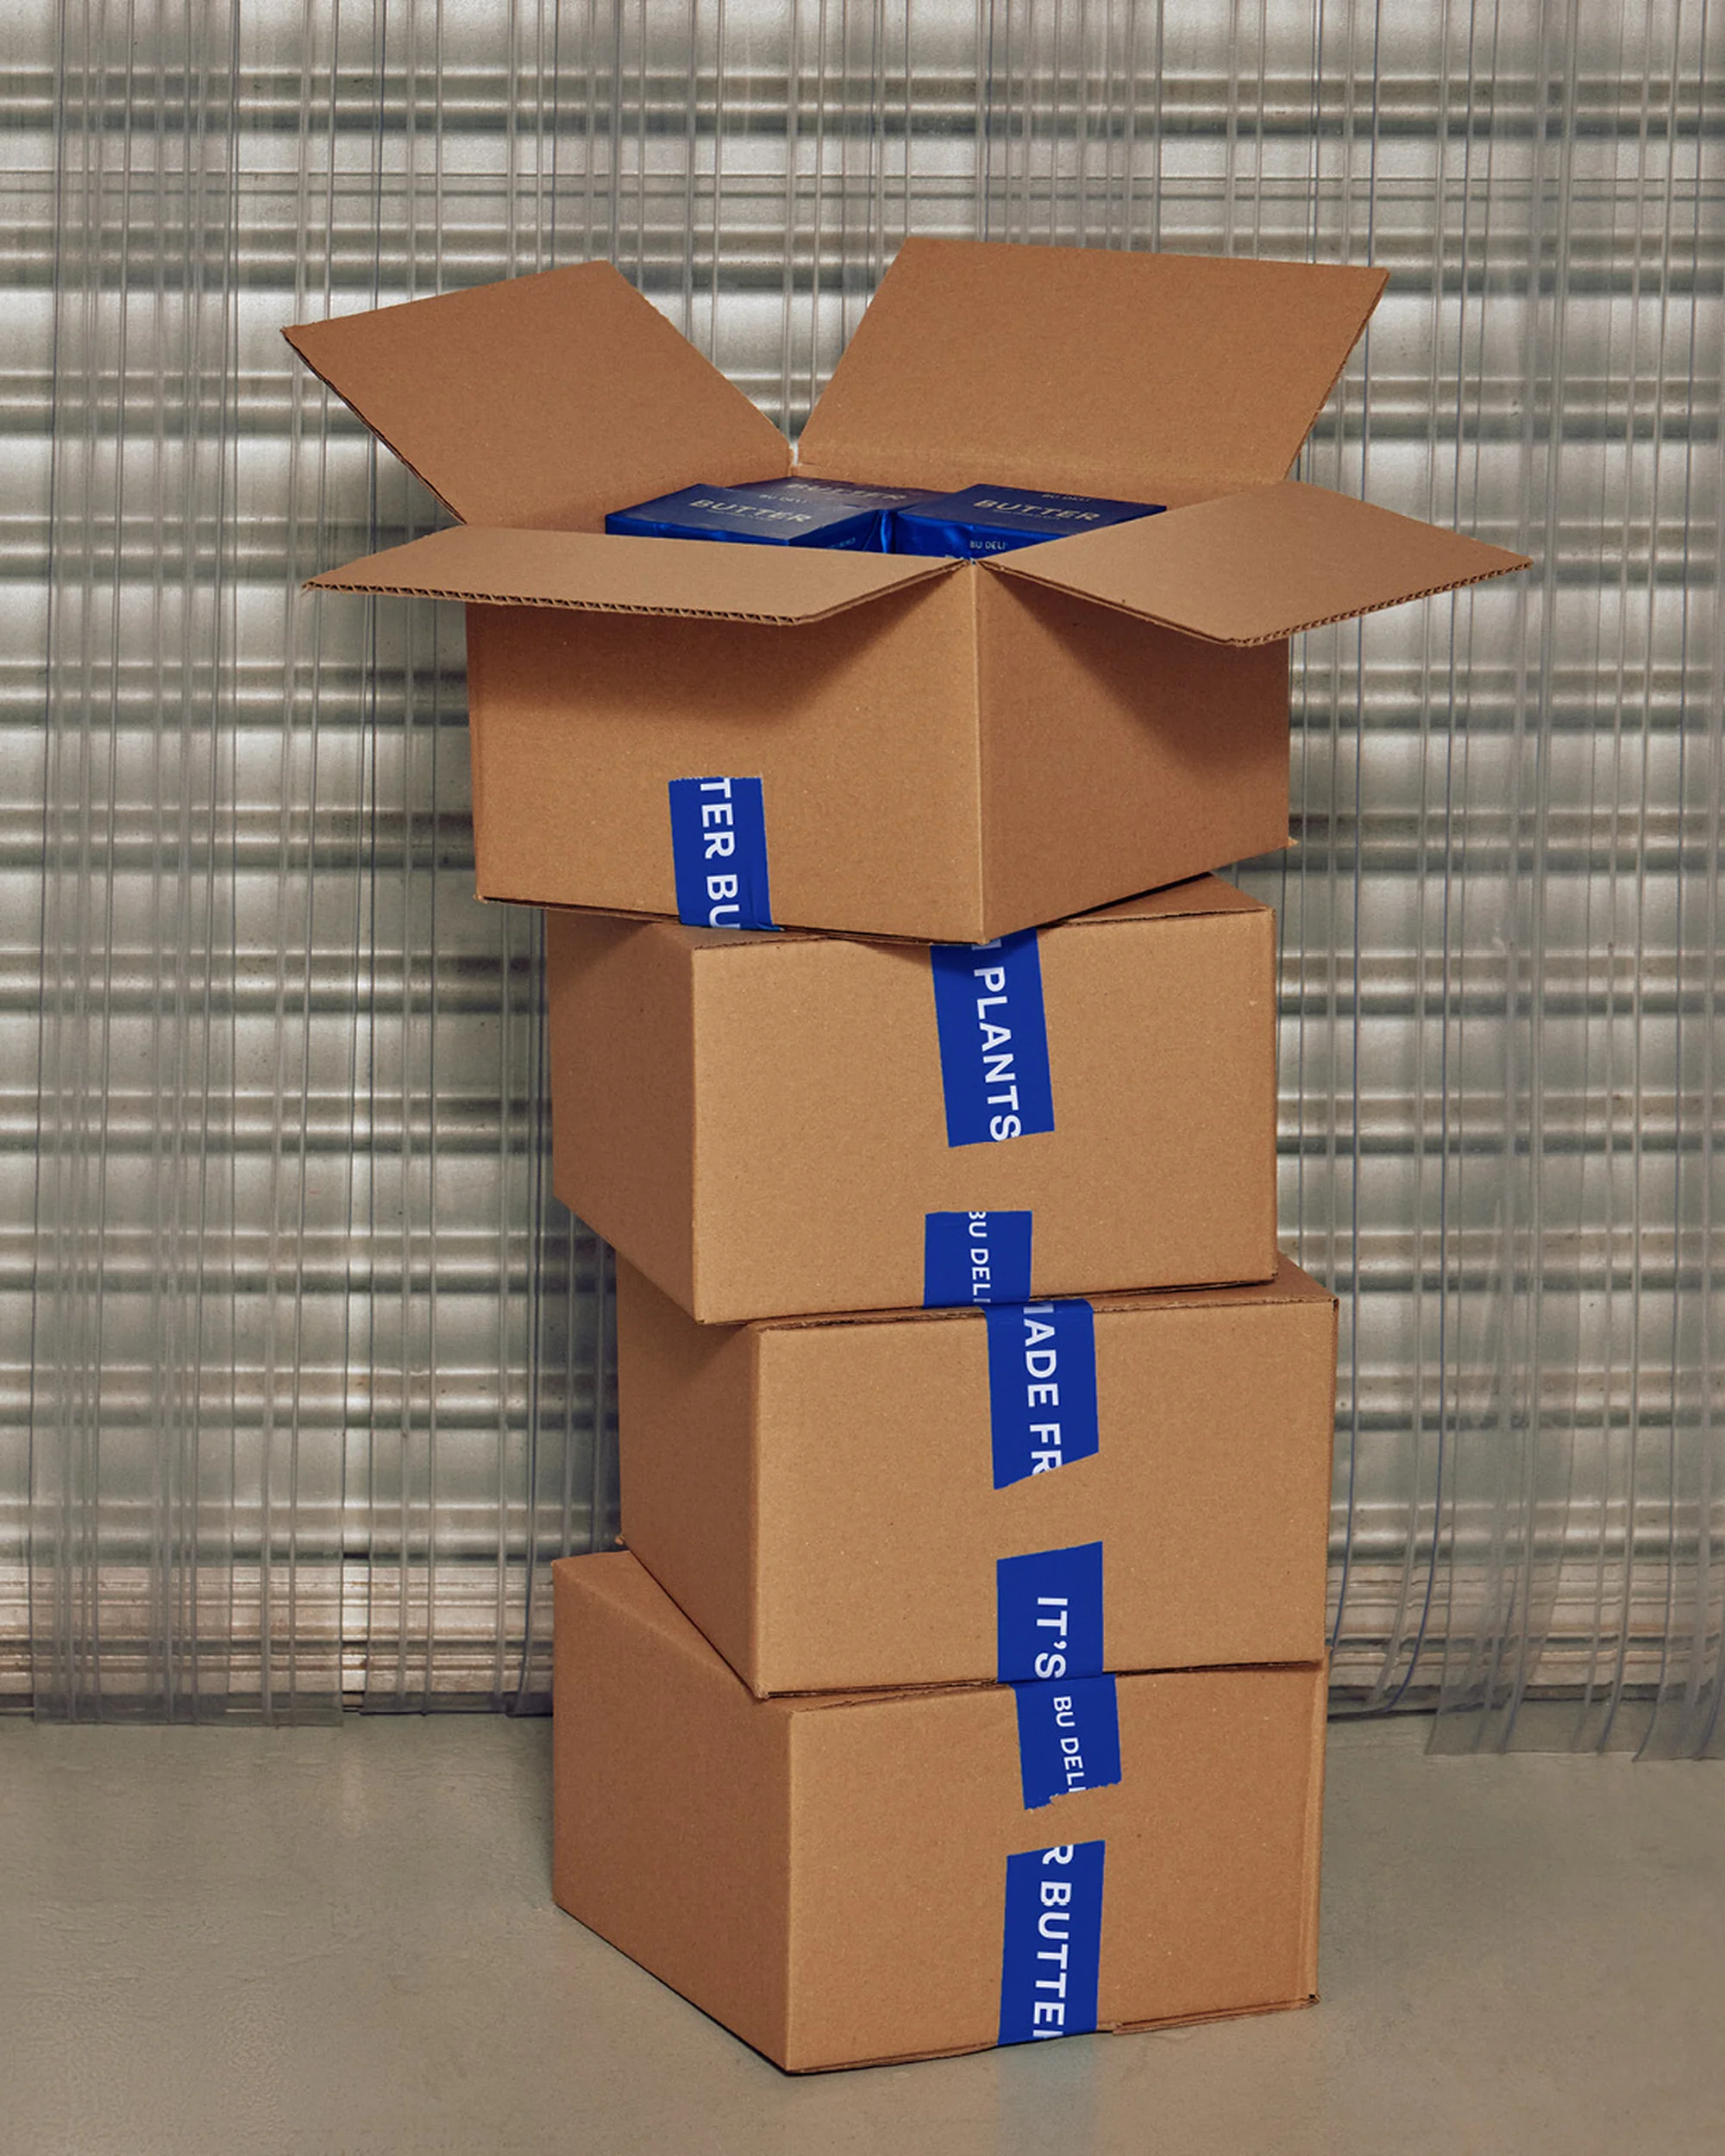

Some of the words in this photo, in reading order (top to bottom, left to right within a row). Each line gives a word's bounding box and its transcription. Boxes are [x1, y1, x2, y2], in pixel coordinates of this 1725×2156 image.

[690, 498, 812, 523] BUTTER
[973, 499, 1101, 521] BUTTER
[969, 540, 983, 550] BU
[700, 778, 735, 859] TER
[707, 874, 742, 930] BU
[974, 967, 1022, 1141] PLANTS
[970, 1249, 991, 1303] DELI
[1035, 1597, 1068, 1678] IT'S
[1053, 1695, 1076, 1727] BU
[1060, 1737, 1086, 1793] DELI
